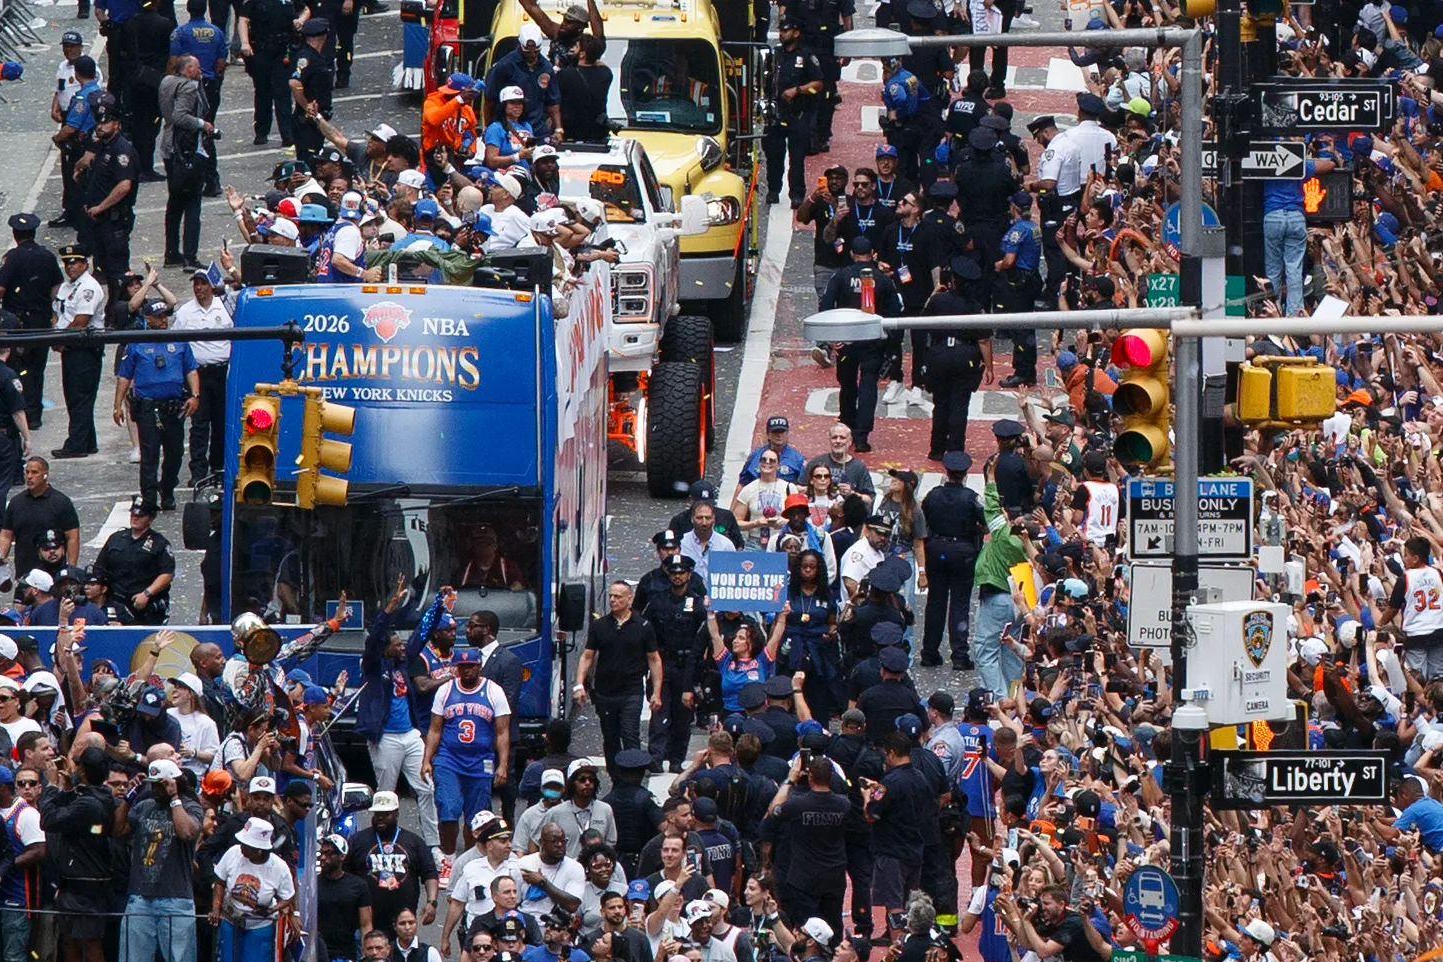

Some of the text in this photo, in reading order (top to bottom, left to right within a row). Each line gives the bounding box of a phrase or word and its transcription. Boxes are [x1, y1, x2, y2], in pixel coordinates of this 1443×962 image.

[1319, 94, 1344, 102] 93-105
[955, 101, 976, 111] NYPD
[1300, 97, 1377, 122] Cedar ST
[1256, 154, 1289, 167] WAY
[303, 314, 470, 337] 2026 NBA
[322, 387, 453, 402] EW YORK KNICKS
[1203, 484, 1238, 496] LANE
[1199, 499, 1239, 512] ONLY
[1100, 505, 1112, 526] 11
[1138, 523, 1176, 534] 7AM-10
[1197, 537, 1225, 547] N-FRI
[710, 573, 785, 589] WON FOR THE
[710, 587, 774, 601] BOROUGHS
[1412, 588, 1441, 612] 32
[1245, 671, 1270, 682] SECURITY
[465, 703, 494, 721] YORK
[1246, 701, 1269, 712] CAMERA
[458, 720, 476, 743] 3
[962, 752, 981, 779] 7
[1305, 760, 1331, 768] 77-101
[1273, 765, 1378, 797] Liberty ST
[802, 812, 845, 827] FDNY
[705, 843, 732, 862] FDNY
[369, 853, 406, 874] NYK
